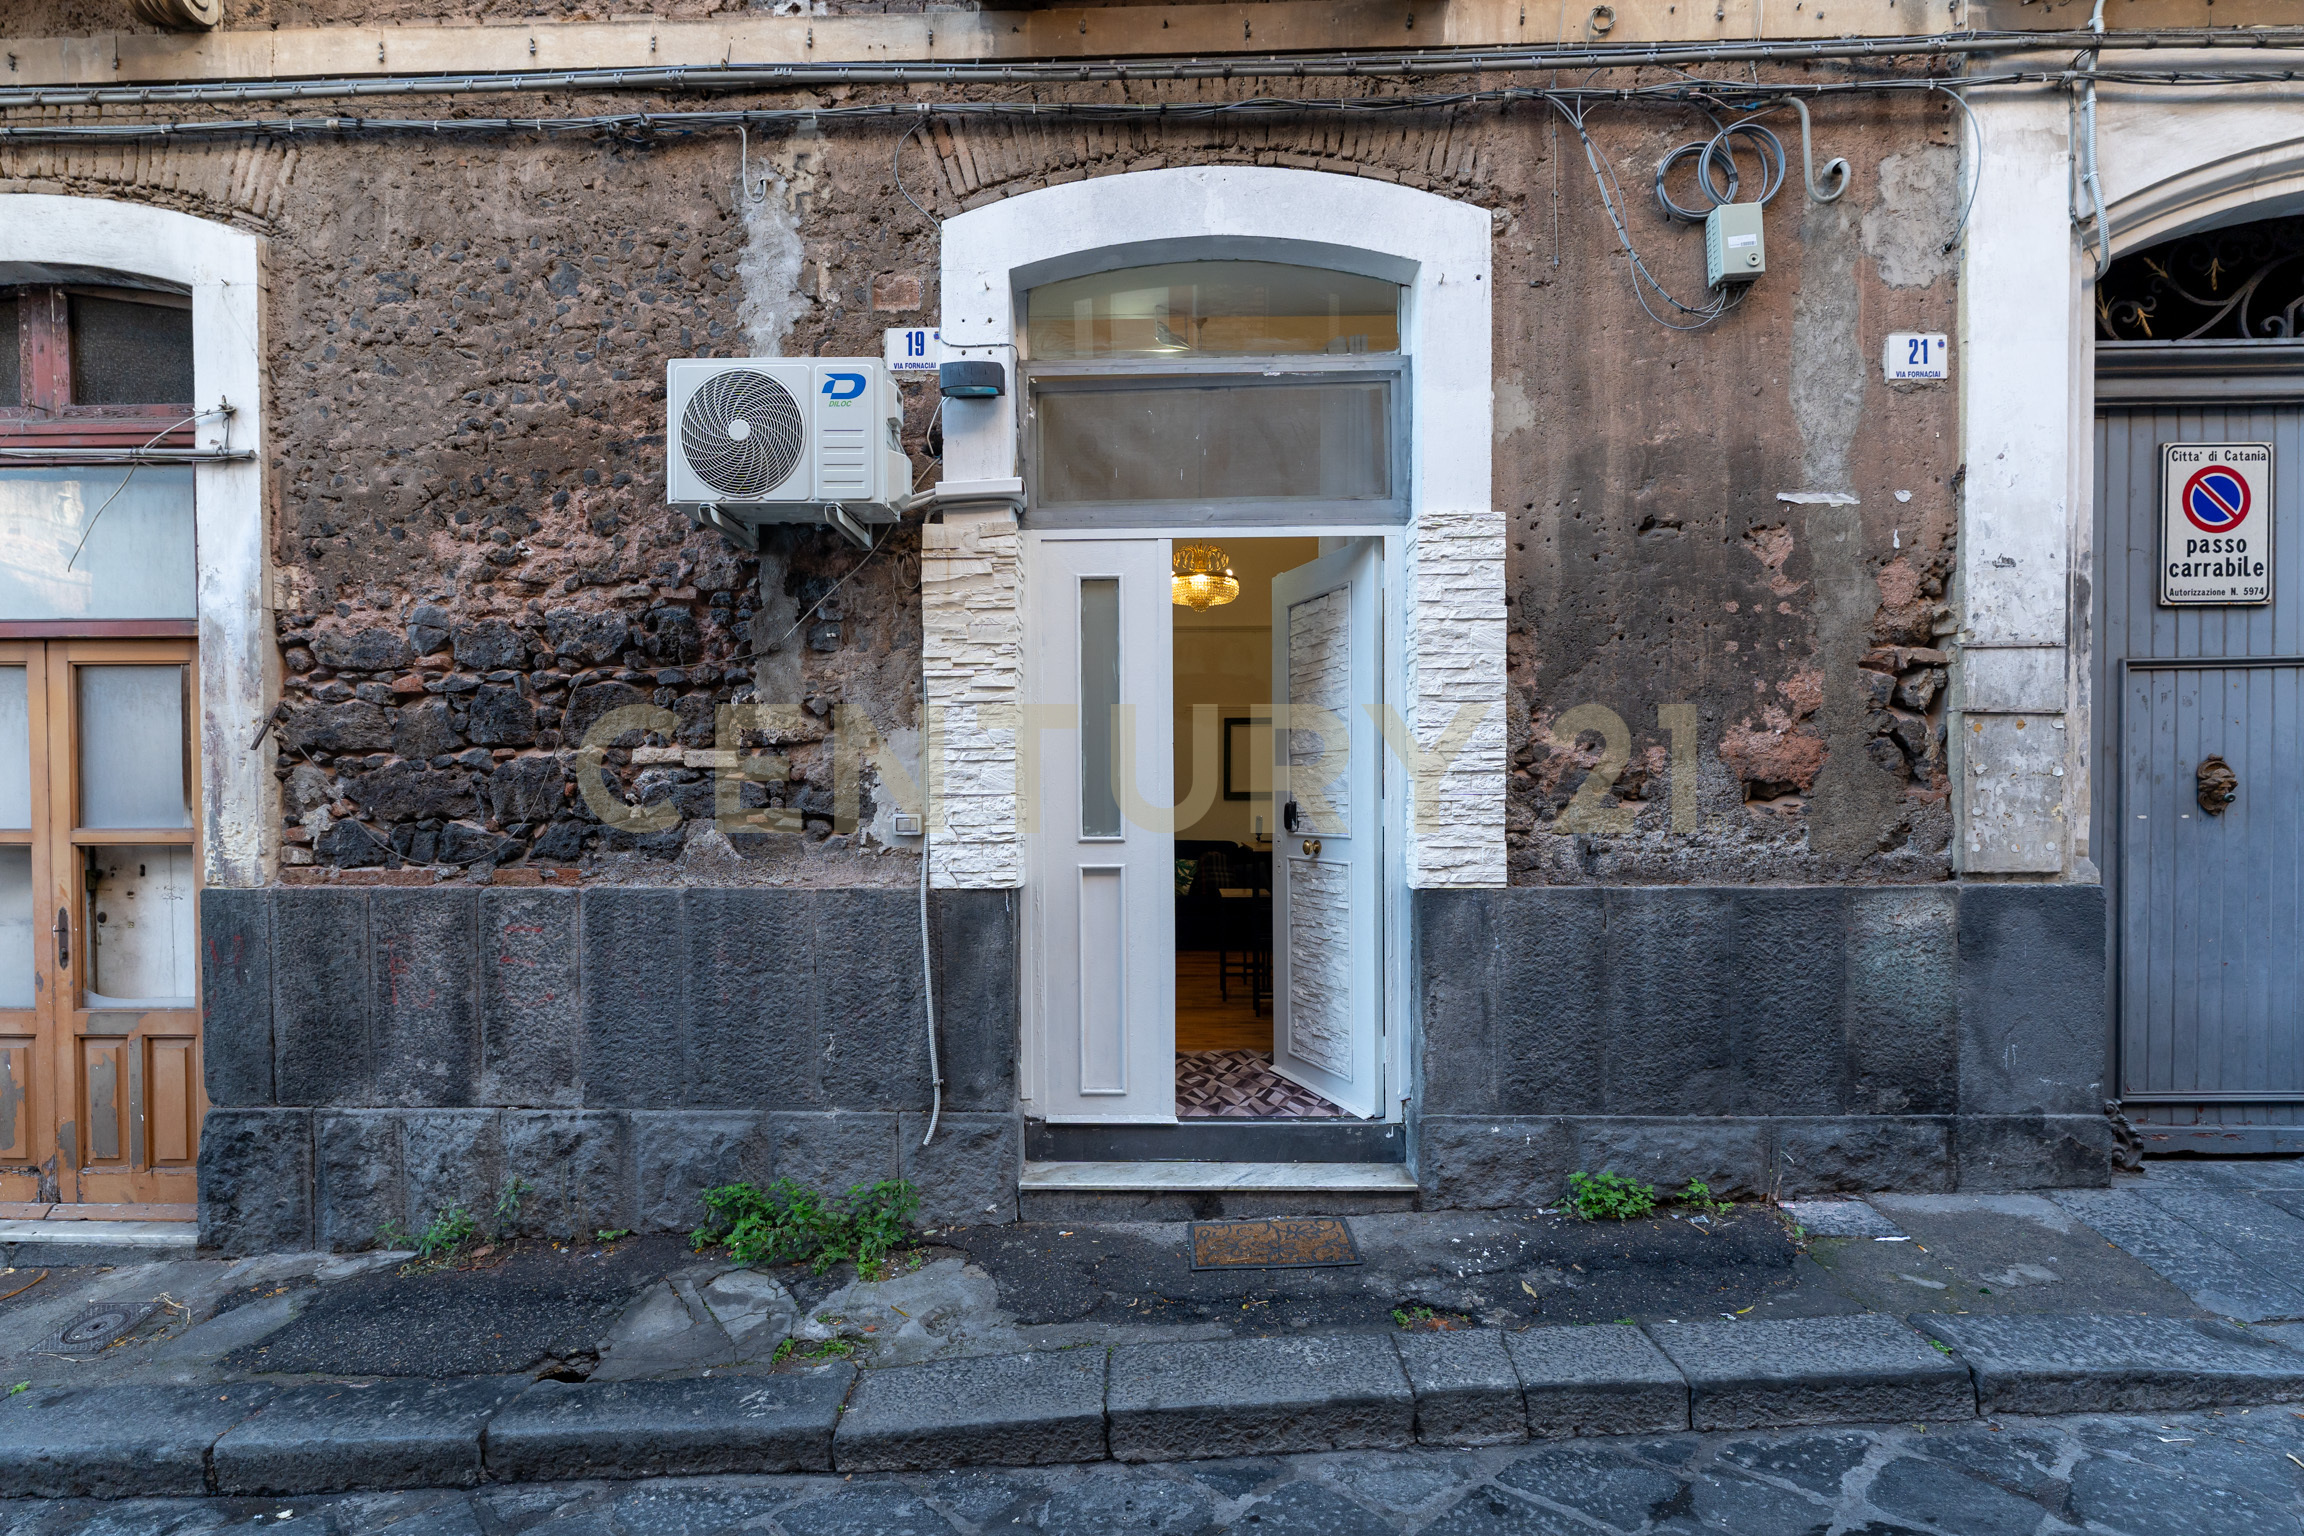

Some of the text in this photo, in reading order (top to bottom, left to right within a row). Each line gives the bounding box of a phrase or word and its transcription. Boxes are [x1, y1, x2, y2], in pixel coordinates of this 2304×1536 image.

[905, 331, 925, 357] 19
[1908, 338, 1928, 365] 21
[893, 362, 937, 370] VIA FORNACIAI
[828, 400, 852, 408] DILOC
[2208, 450, 2218, 462] di
[2224, 449, 2267, 462] Catania
[2186, 538, 2247, 558] passo
[2168, 555, 2264, 578] carrabile
[2169, 586, 2264, 597] Autorizzazione N. 5974
